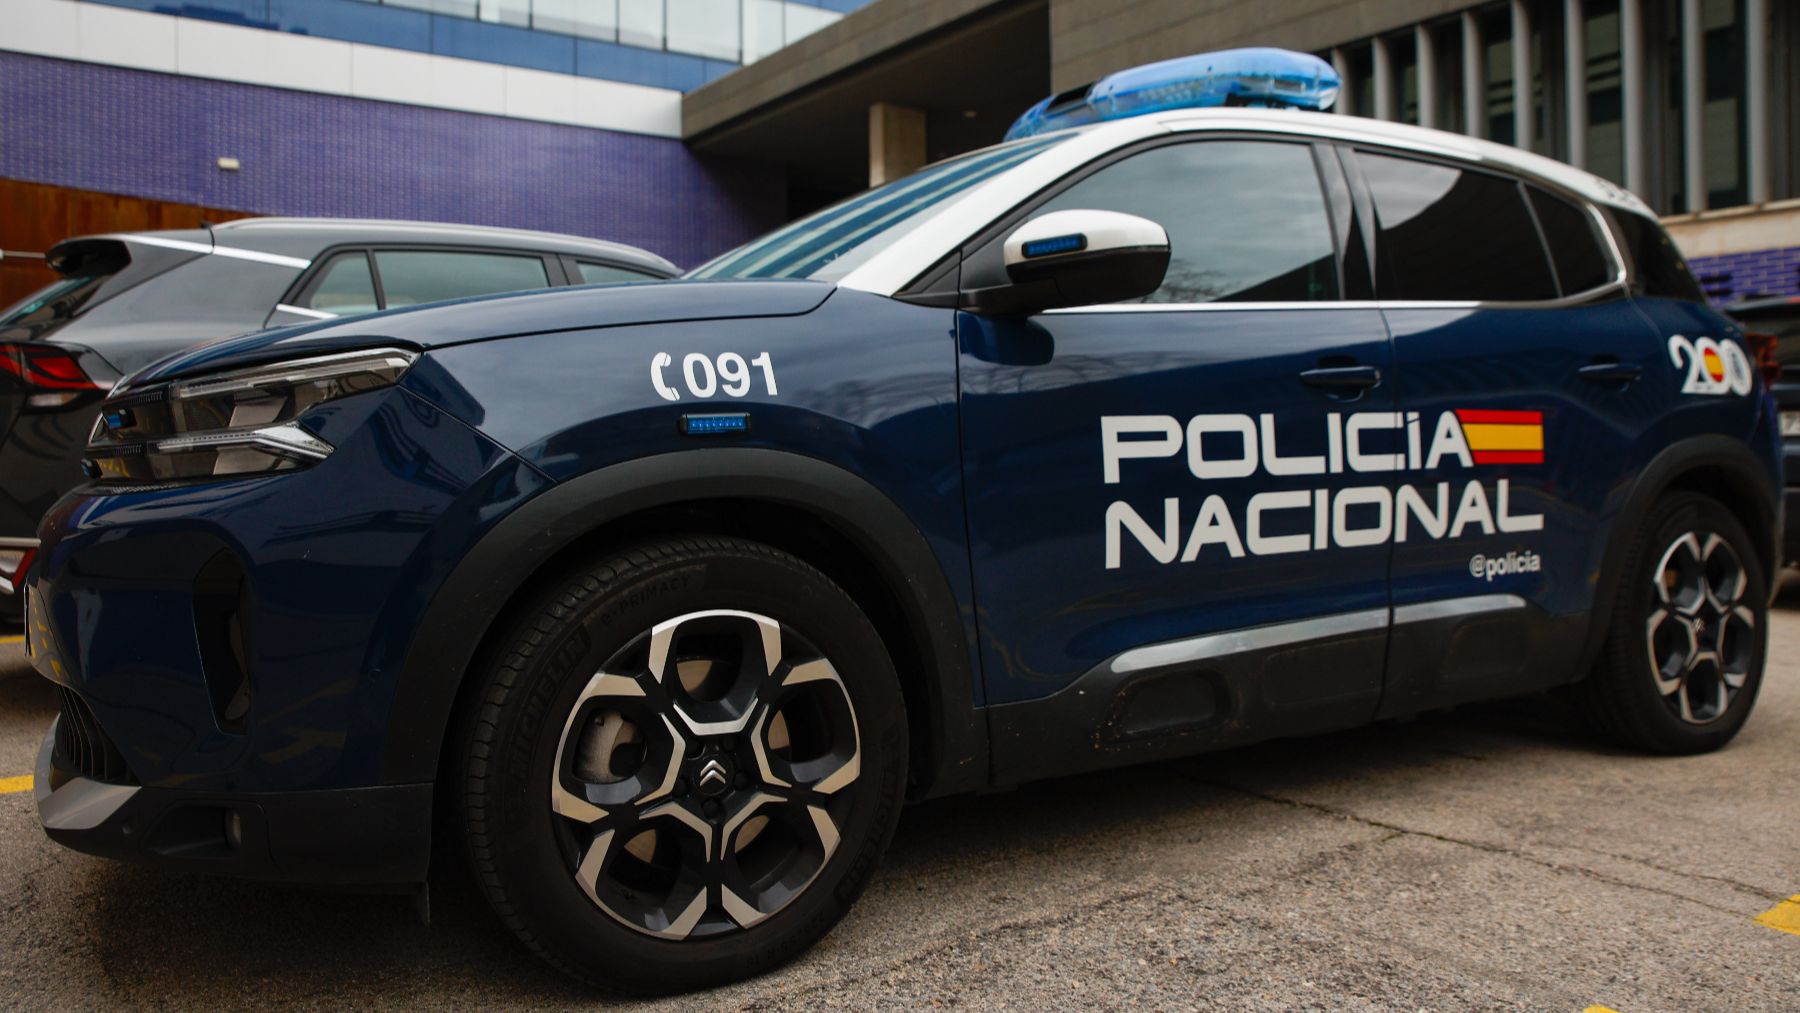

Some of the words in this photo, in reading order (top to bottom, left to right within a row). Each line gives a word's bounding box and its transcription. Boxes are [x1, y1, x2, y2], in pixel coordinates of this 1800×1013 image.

[683, 351, 778, 398] 091
[1668, 334, 1752, 396] 200
[1105, 478, 1544, 569] NACIONAL
